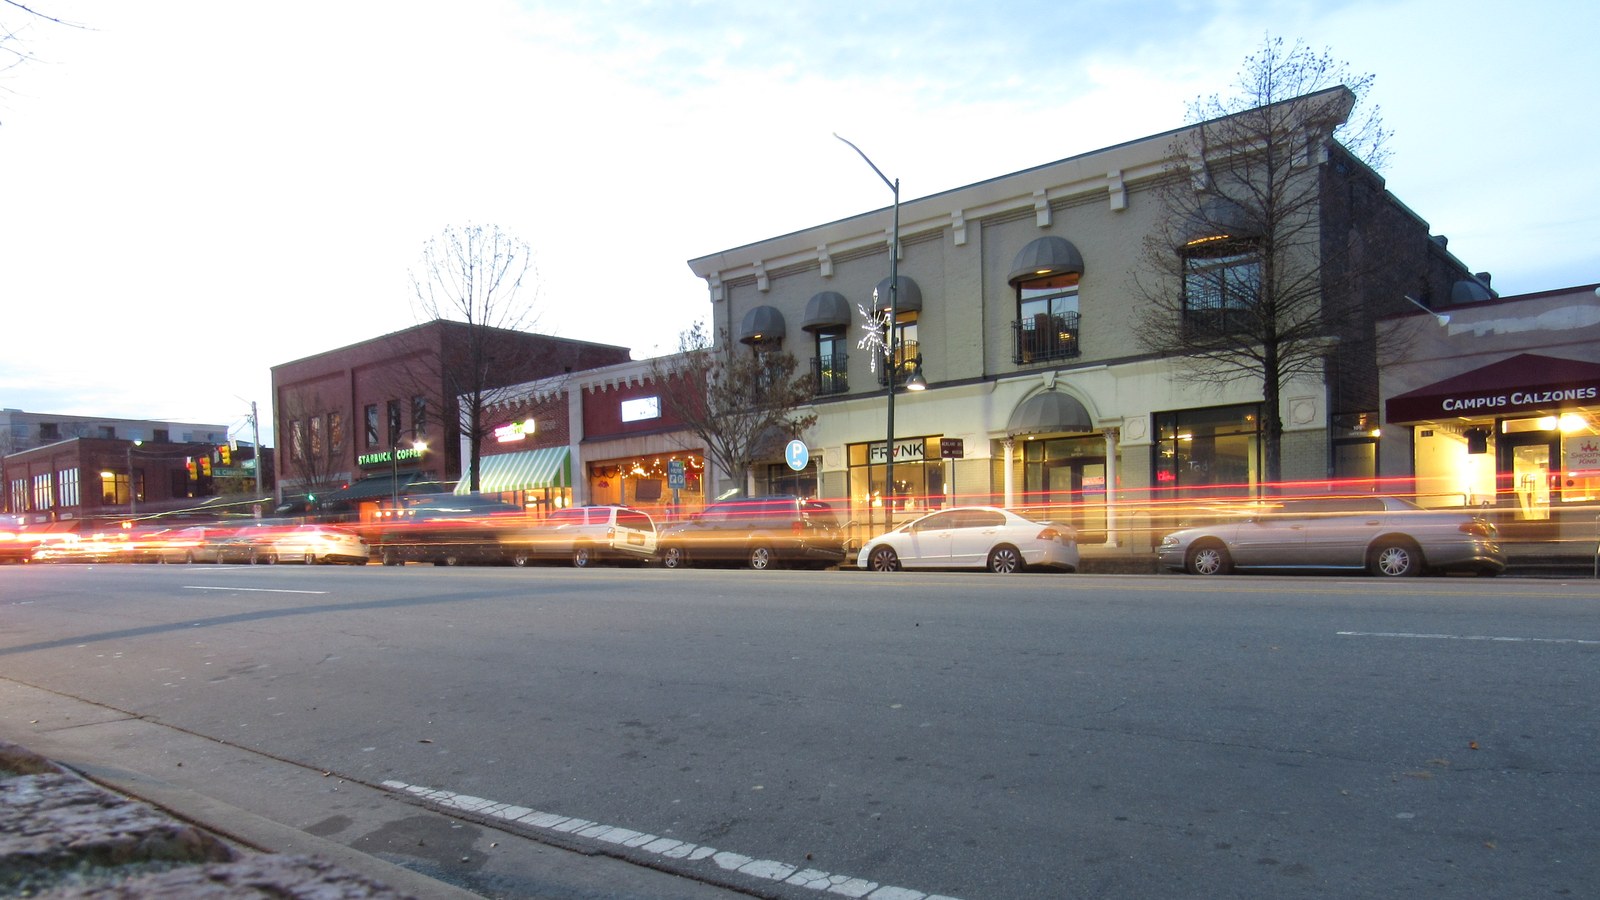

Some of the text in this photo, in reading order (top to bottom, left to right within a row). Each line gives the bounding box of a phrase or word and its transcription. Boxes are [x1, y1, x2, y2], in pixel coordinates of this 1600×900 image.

[1442, 387, 1597, 411] CAMPUS CALZONES
[358, 451, 396, 465] STARBUCK
[792, 443, 802, 459] P
